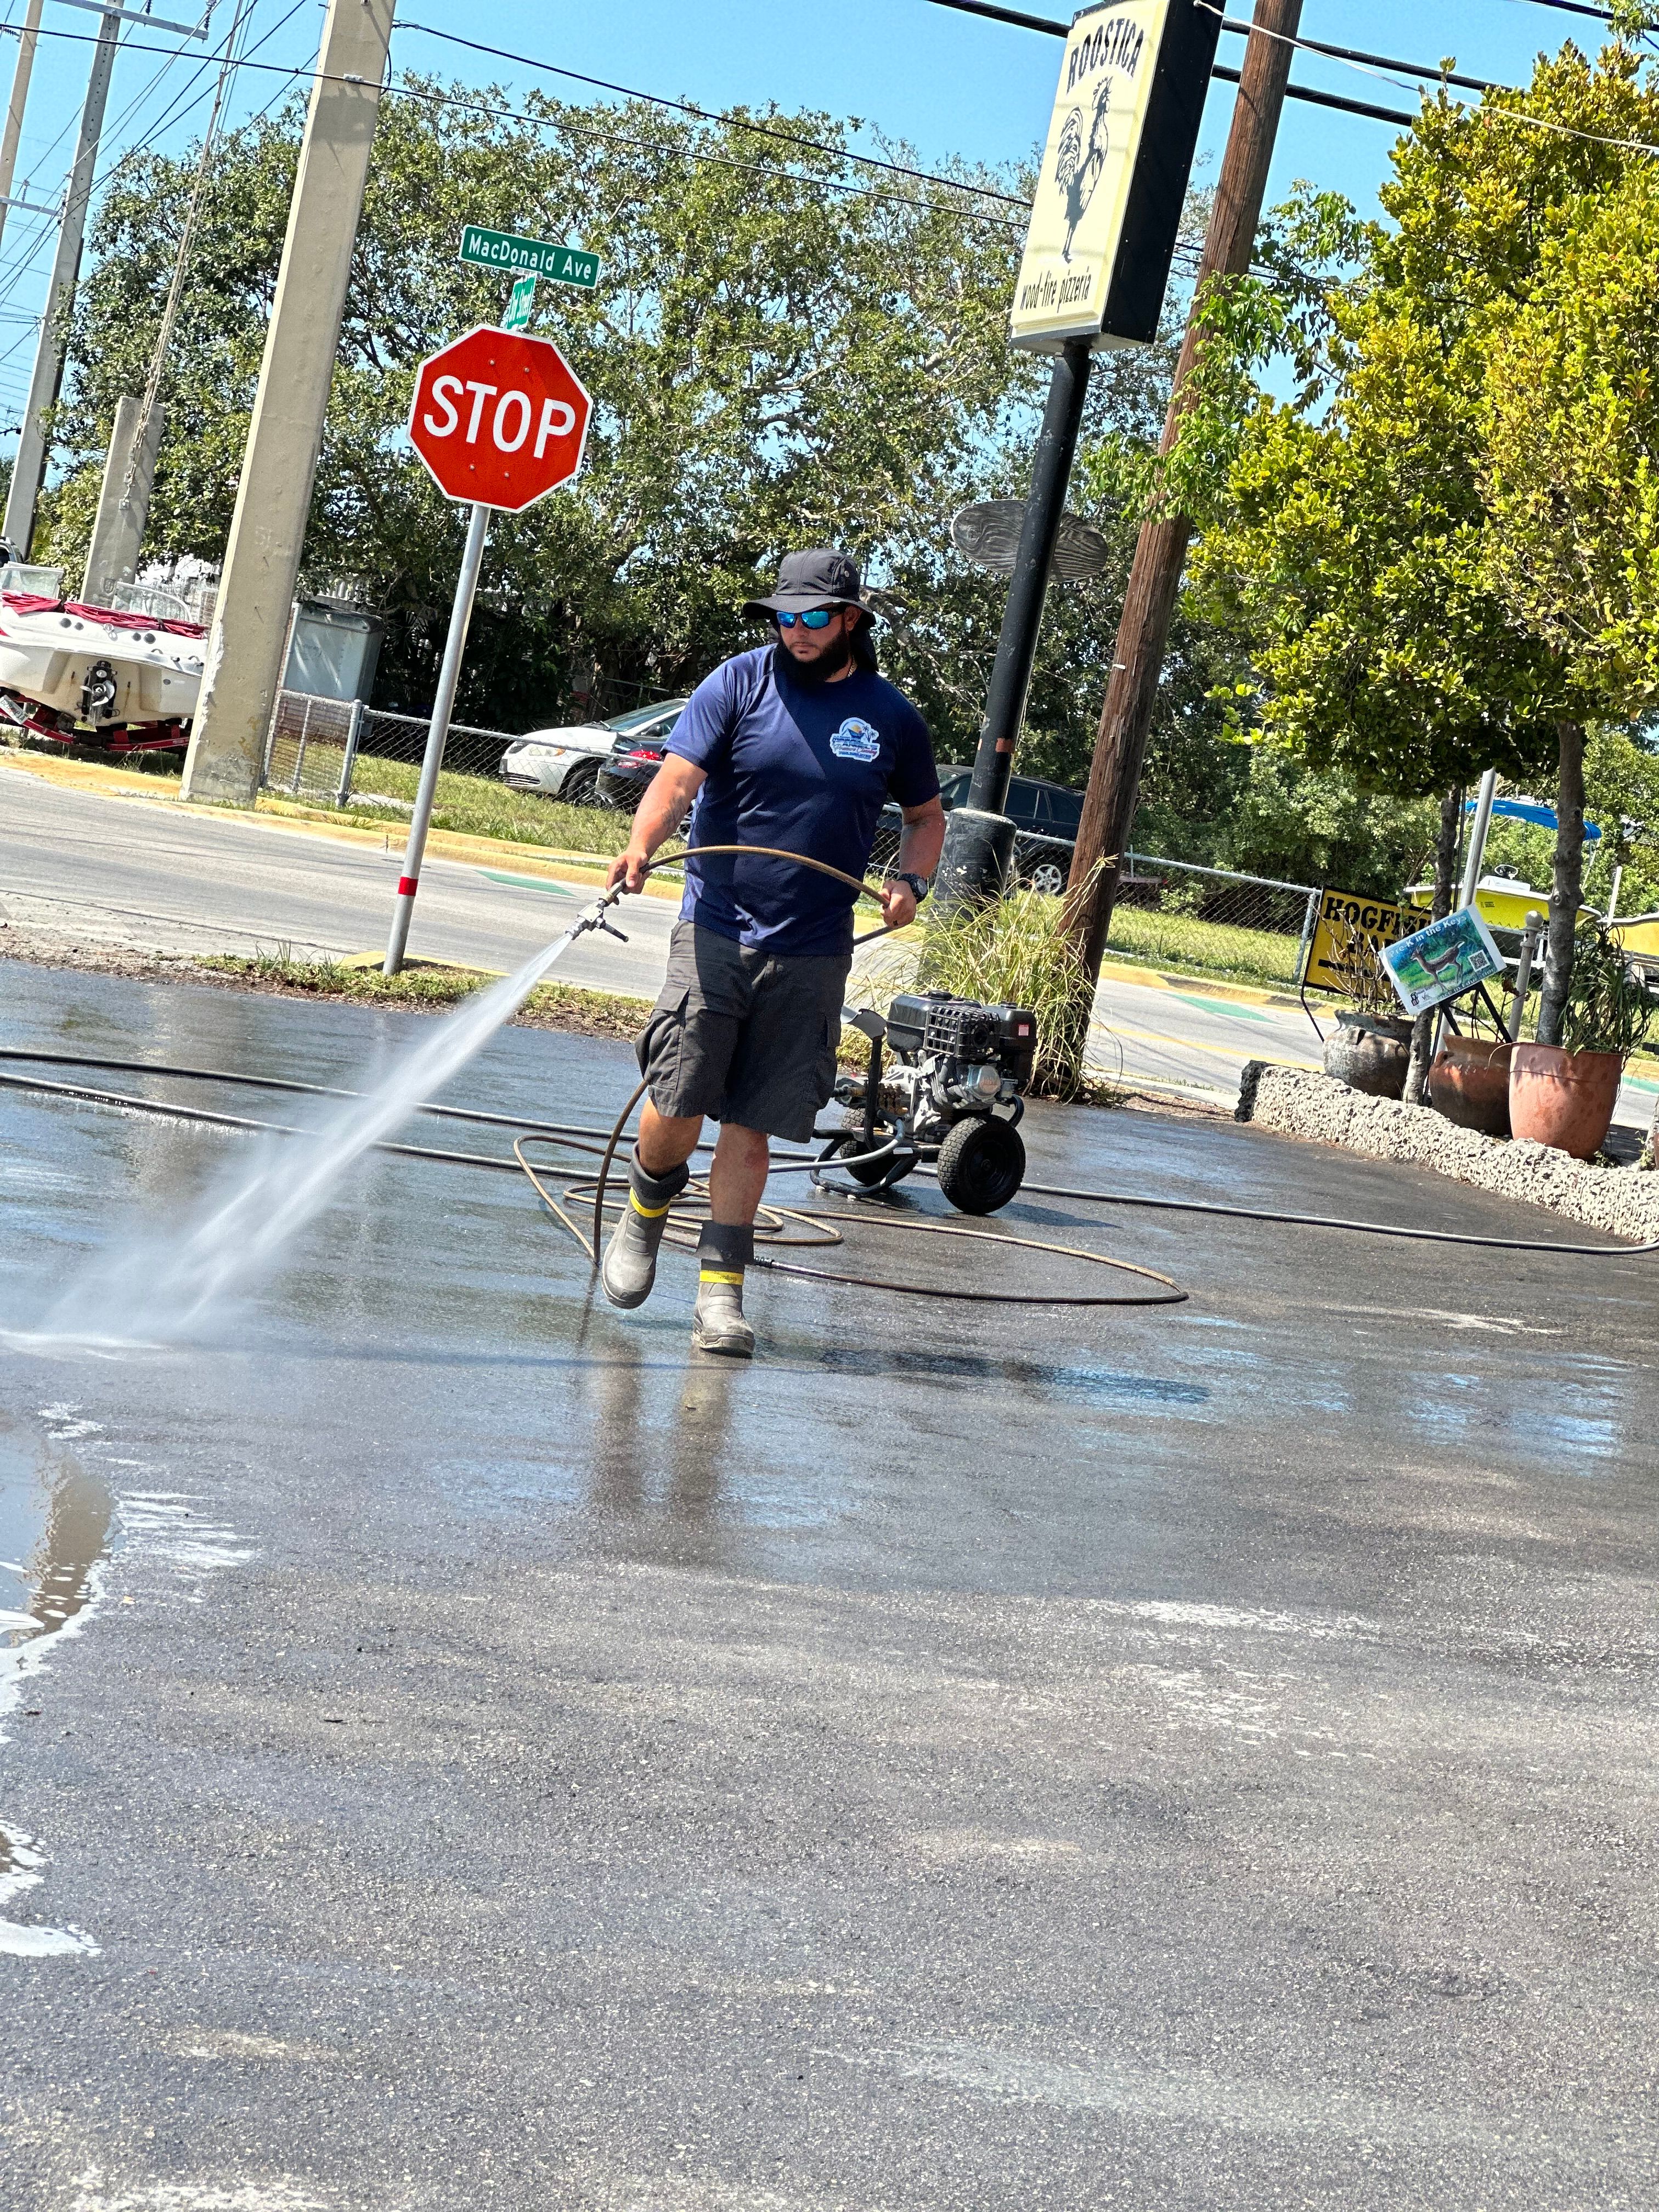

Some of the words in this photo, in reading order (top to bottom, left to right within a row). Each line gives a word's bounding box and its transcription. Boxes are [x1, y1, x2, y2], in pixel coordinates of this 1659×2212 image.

[1066, 18, 1144, 95] ROOSTICA
[468, 233, 555, 272] MacDonald
[562, 255, 591, 279] Ave
[1020, 270, 1057, 311] wood-fire
[1057, 266, 1091, 313] pizzeria
[424, 375, 575, 459] STOP
[1388, 936, 1415, 957] Pre-K
[1415, 934, 1425, 942] in
[1425, 924, 1442, 937] the
[1443, 915, 1467, 929] Keys
